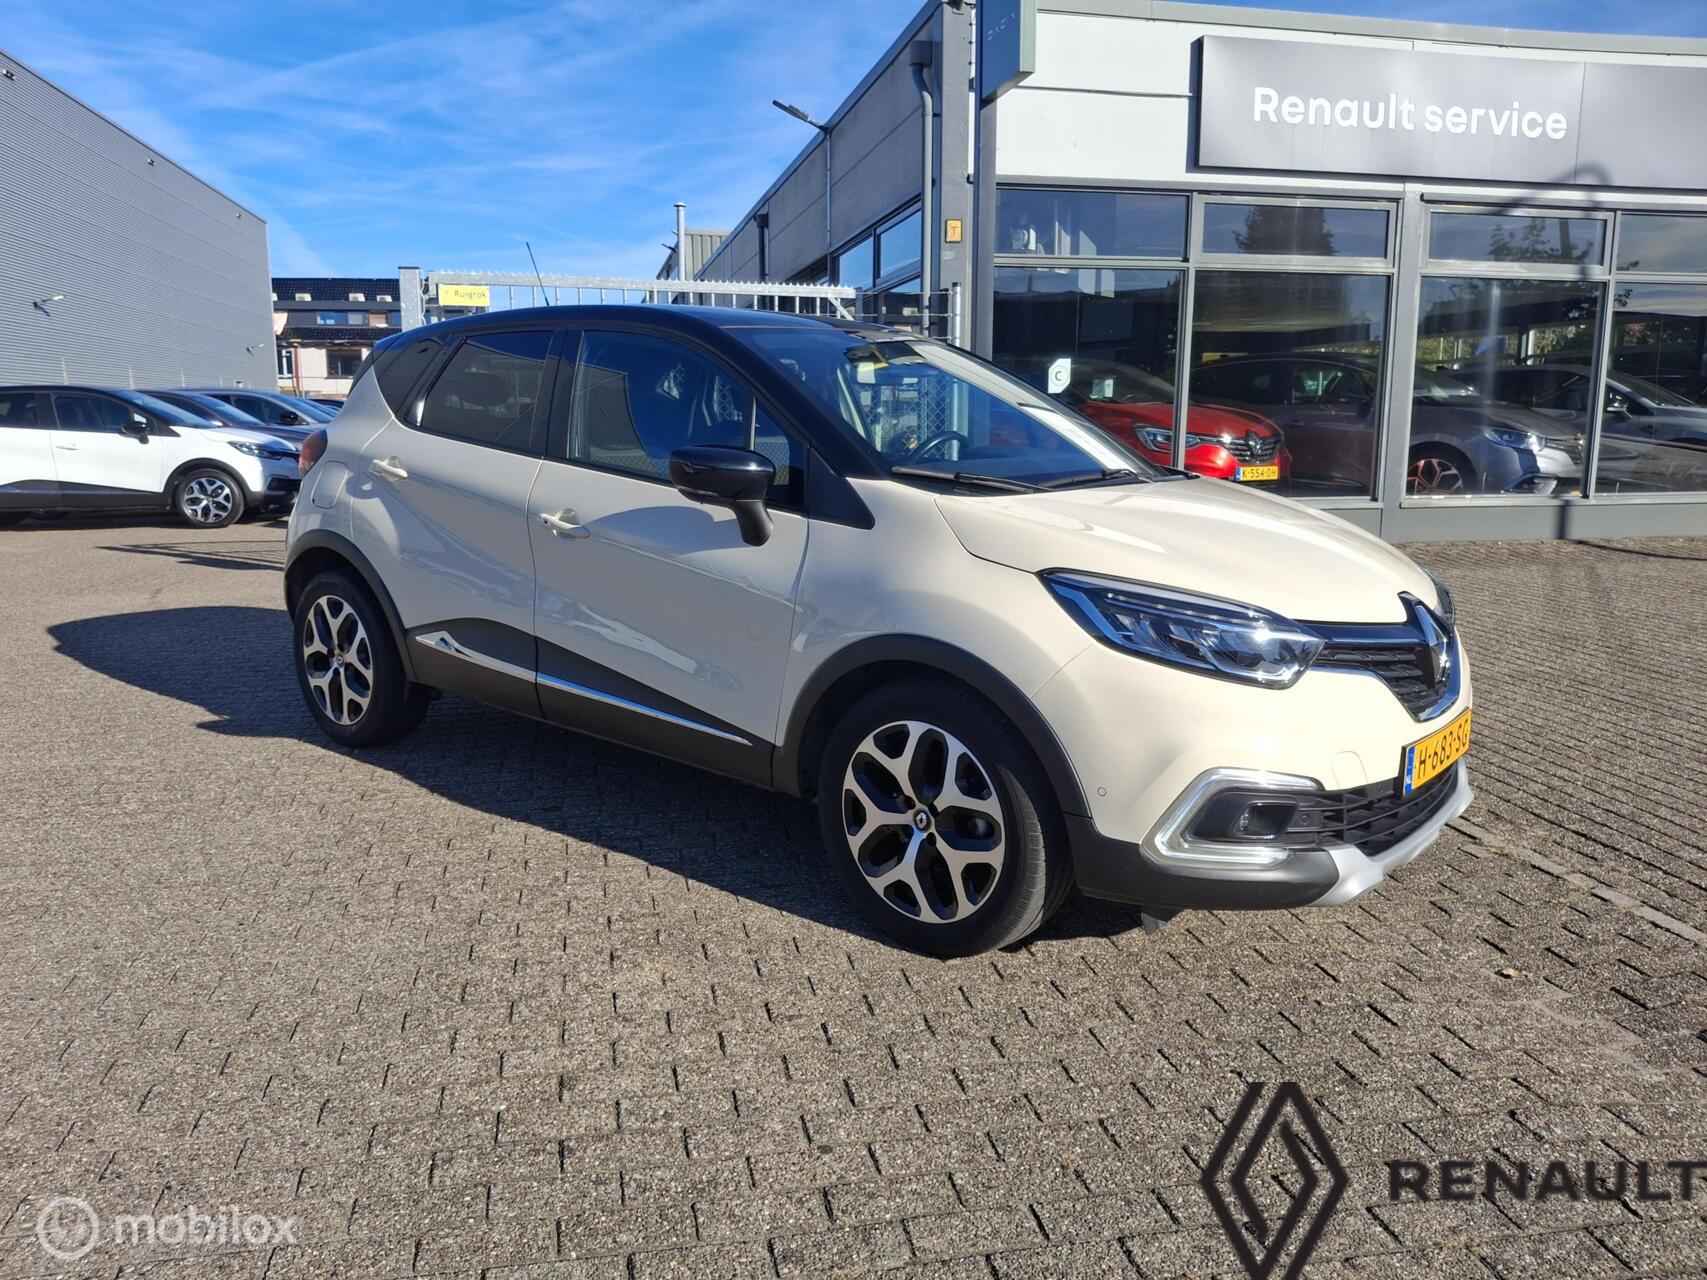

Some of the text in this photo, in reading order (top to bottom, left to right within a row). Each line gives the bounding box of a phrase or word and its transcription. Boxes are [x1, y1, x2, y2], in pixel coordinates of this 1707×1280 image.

[1253, 87, 1568, 140] Renault service
[1242, 468, 1277, 478] K-554-DH
[1418, 718, 1469, 780] H-683-SG
